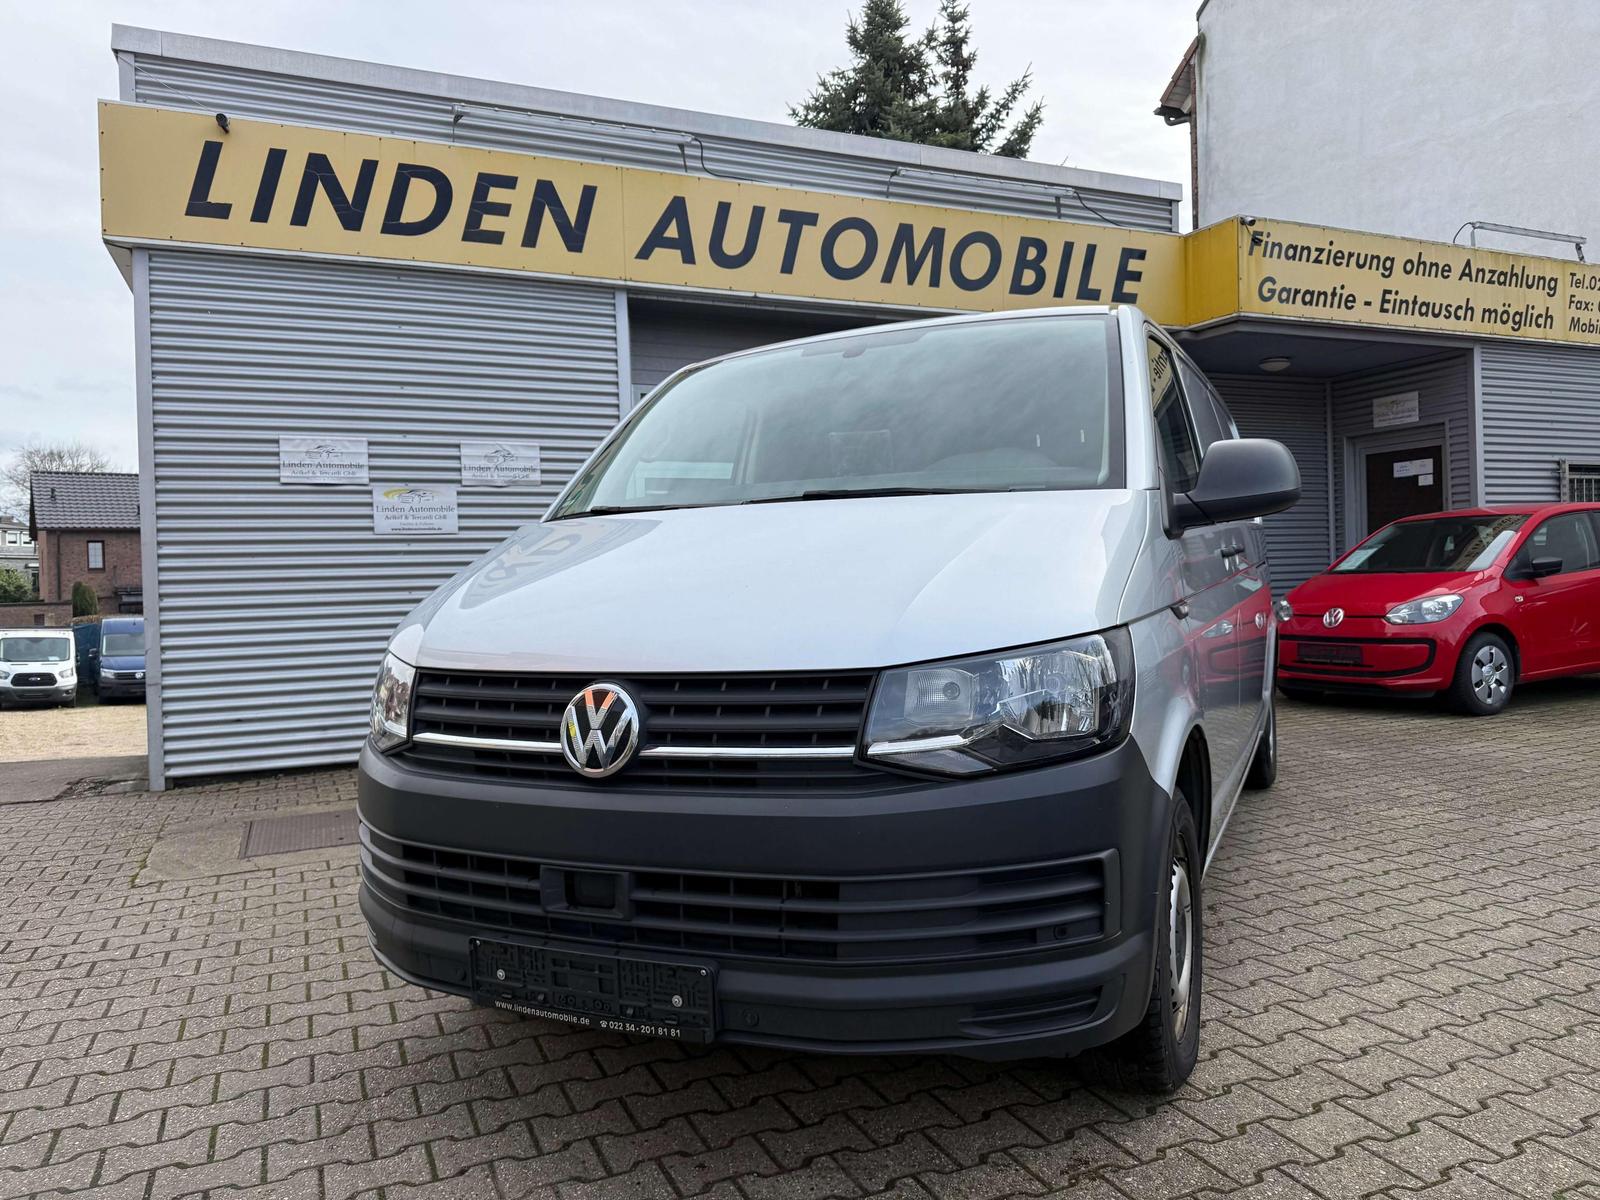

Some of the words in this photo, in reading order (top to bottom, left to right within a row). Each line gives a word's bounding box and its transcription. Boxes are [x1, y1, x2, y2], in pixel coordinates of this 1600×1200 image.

[184, 140, 597, 253] LINDEN
[635, 195, 1147, 305] AUTOMOBILE
[1248, 230, 1395, 279] Finanzierung
[1403, 252, 1452, 279] ohne
[1458, 258, 1558, 297] Anzahlung
[1258, 276, 1356, 310] Garantie
[1379, 289, 1475, 322] Eintausch
[1481, 302, 1554, 332] möglich
[1568, 294, 1594, 312] Fax:
[282, 460, 313, 468] Linden
[315, 461, 365, 469] Automobile
[408, 505, 456, 513] Automobile
[494, 1000, 590, 1026] www.lindenautomobile.de
[609, 1021, 624, 1031] 022
[625, 1023, 635, 1032] 34
[640, 1025, 656, 1035] 201
[658, 1027, 668, 1036] 81
[670, 1028, 681, 1037] 81
